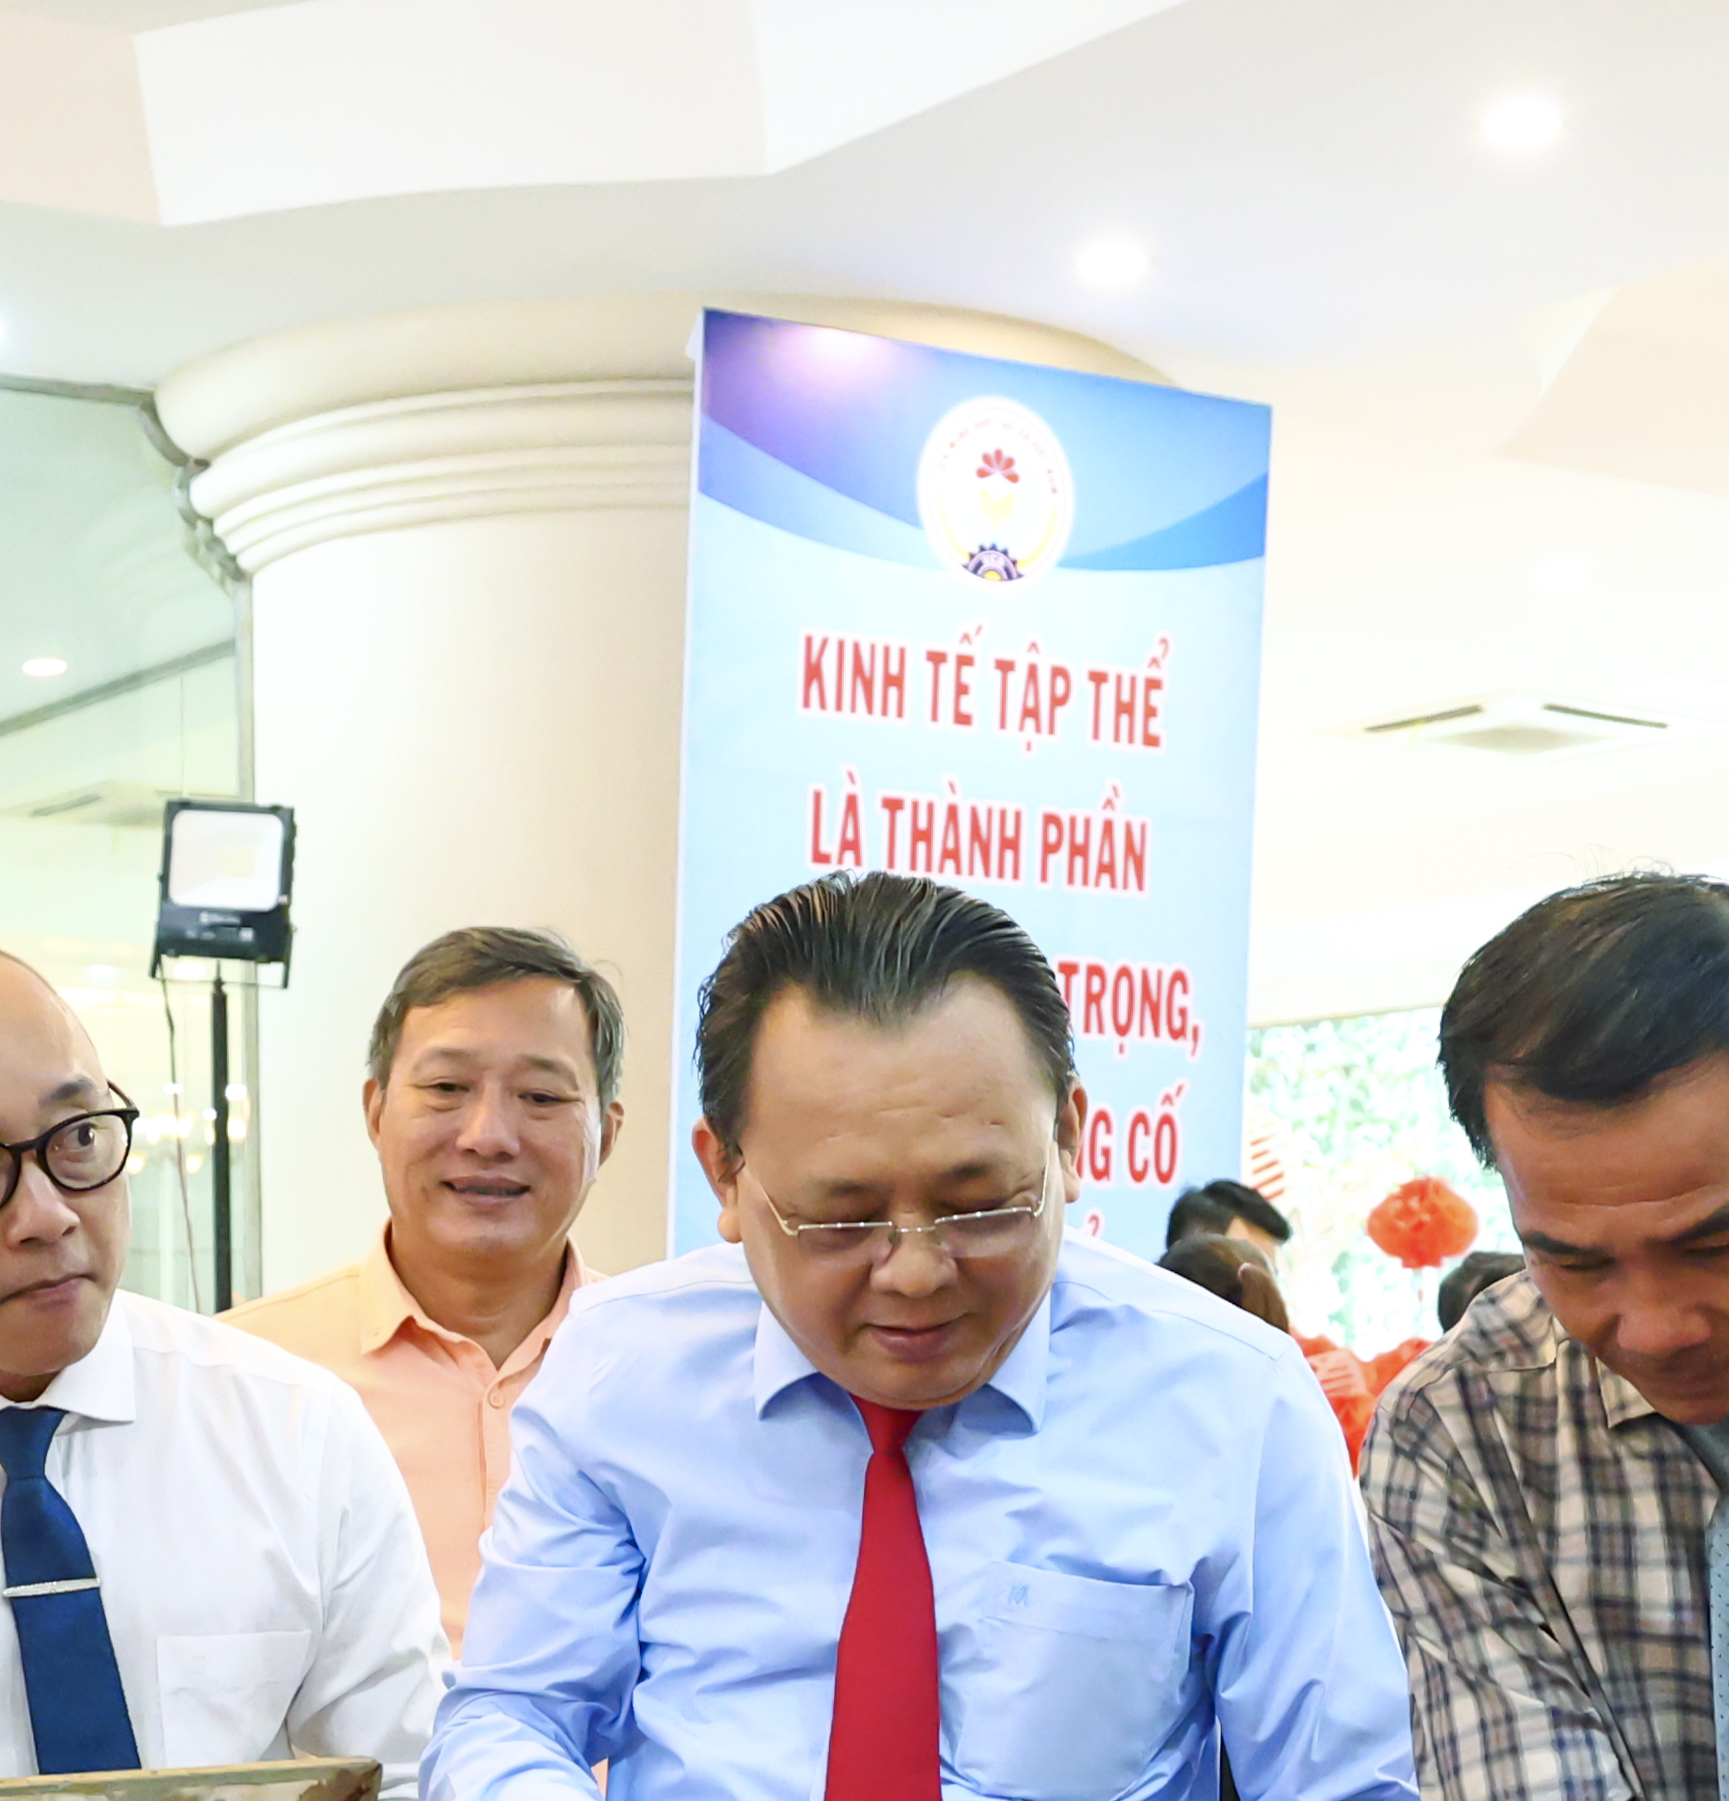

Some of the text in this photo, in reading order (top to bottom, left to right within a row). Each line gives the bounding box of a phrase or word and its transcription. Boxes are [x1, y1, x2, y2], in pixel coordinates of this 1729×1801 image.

[802, 624, 1169, 752] KINH TẾ TẬP THỂ
[811, 770, 1148, 892] LÀ THÀNH PHẦN
[1057, 961, 1200, 1057] TRỌNG,
[1128, 1083, 1185, 1184] CỐ
